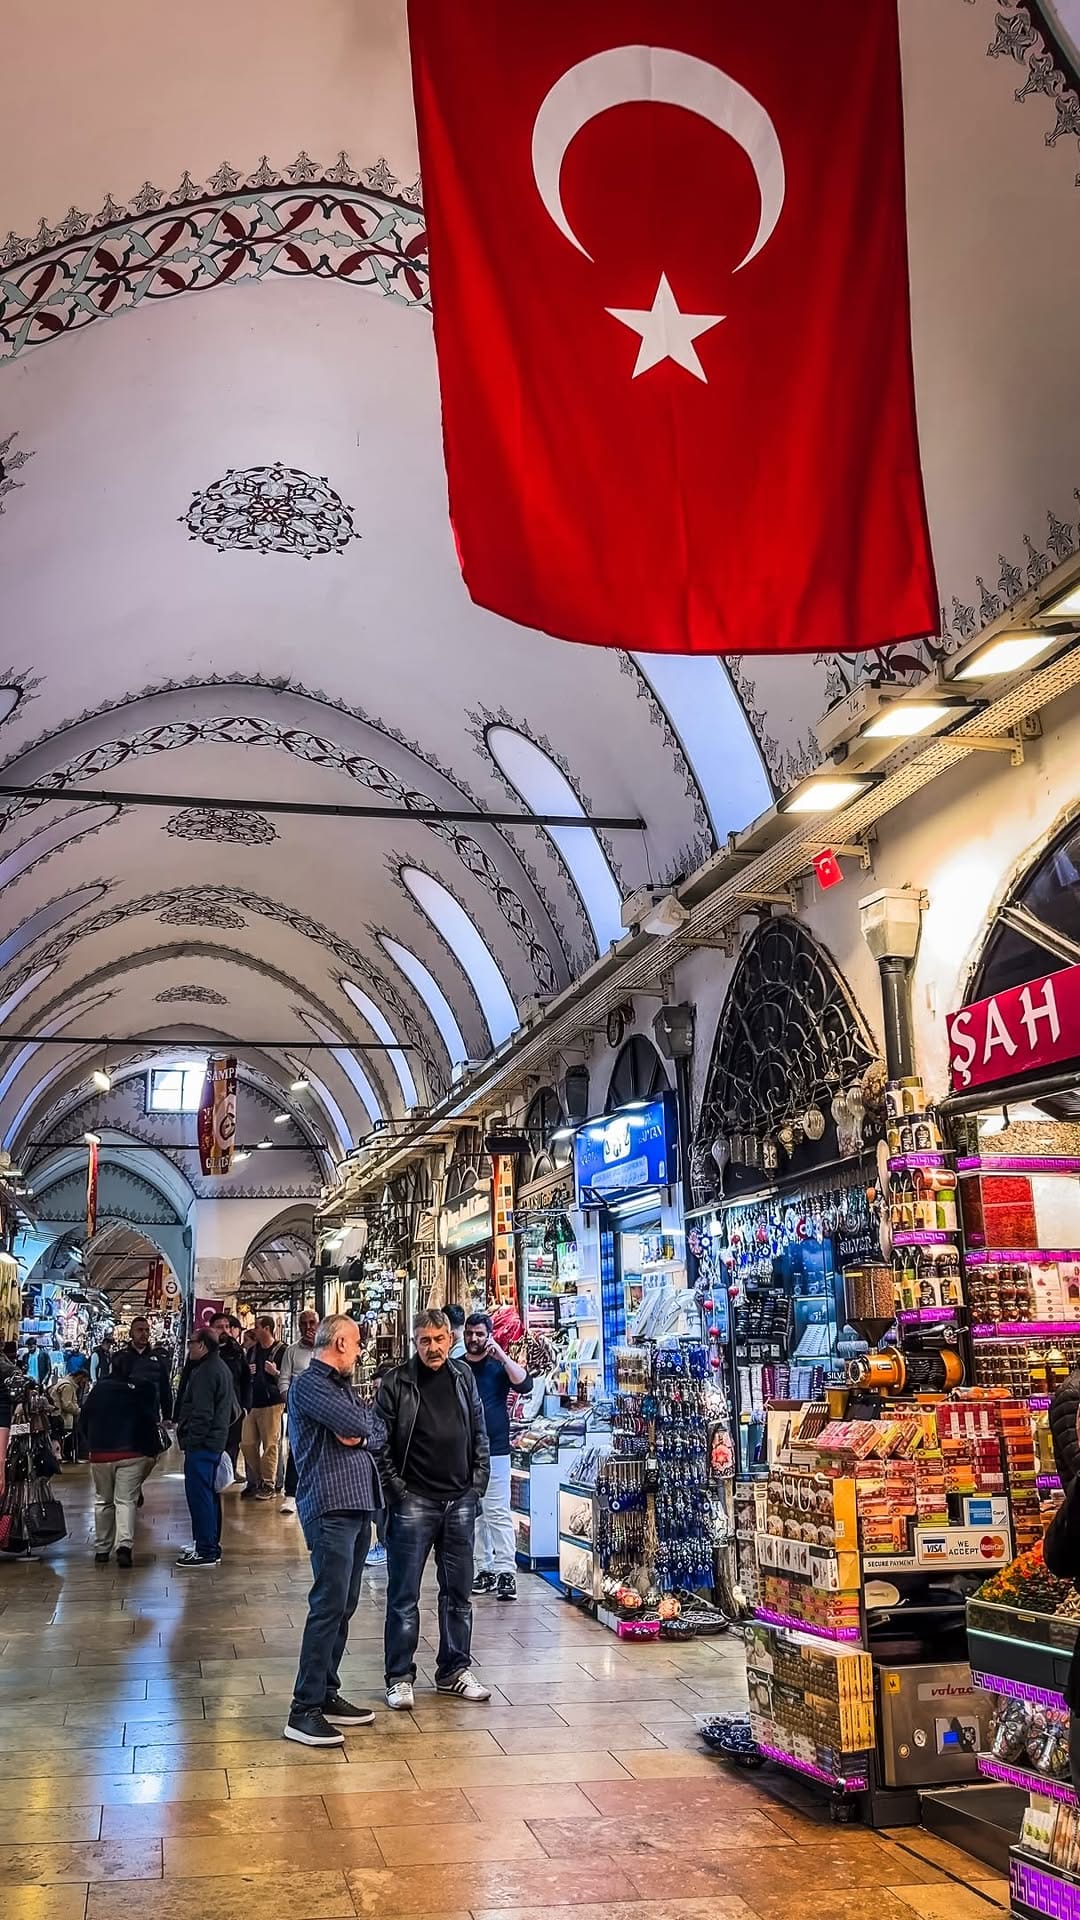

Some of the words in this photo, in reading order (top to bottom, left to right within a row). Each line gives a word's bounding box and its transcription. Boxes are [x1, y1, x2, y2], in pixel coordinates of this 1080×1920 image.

[950, 978, 1061, 1086] ŞAH
[827, 1371, 847, 1380] SILVE
[926, 1544, 943, 1553] VISA
[957, 1540, 969, 1548] WE
[948, 1547, 979, 1556] ACCEPT
[867, 1560, 889, 1568] SECURE
[889, 1559, 914, 1568] PAYMENT
